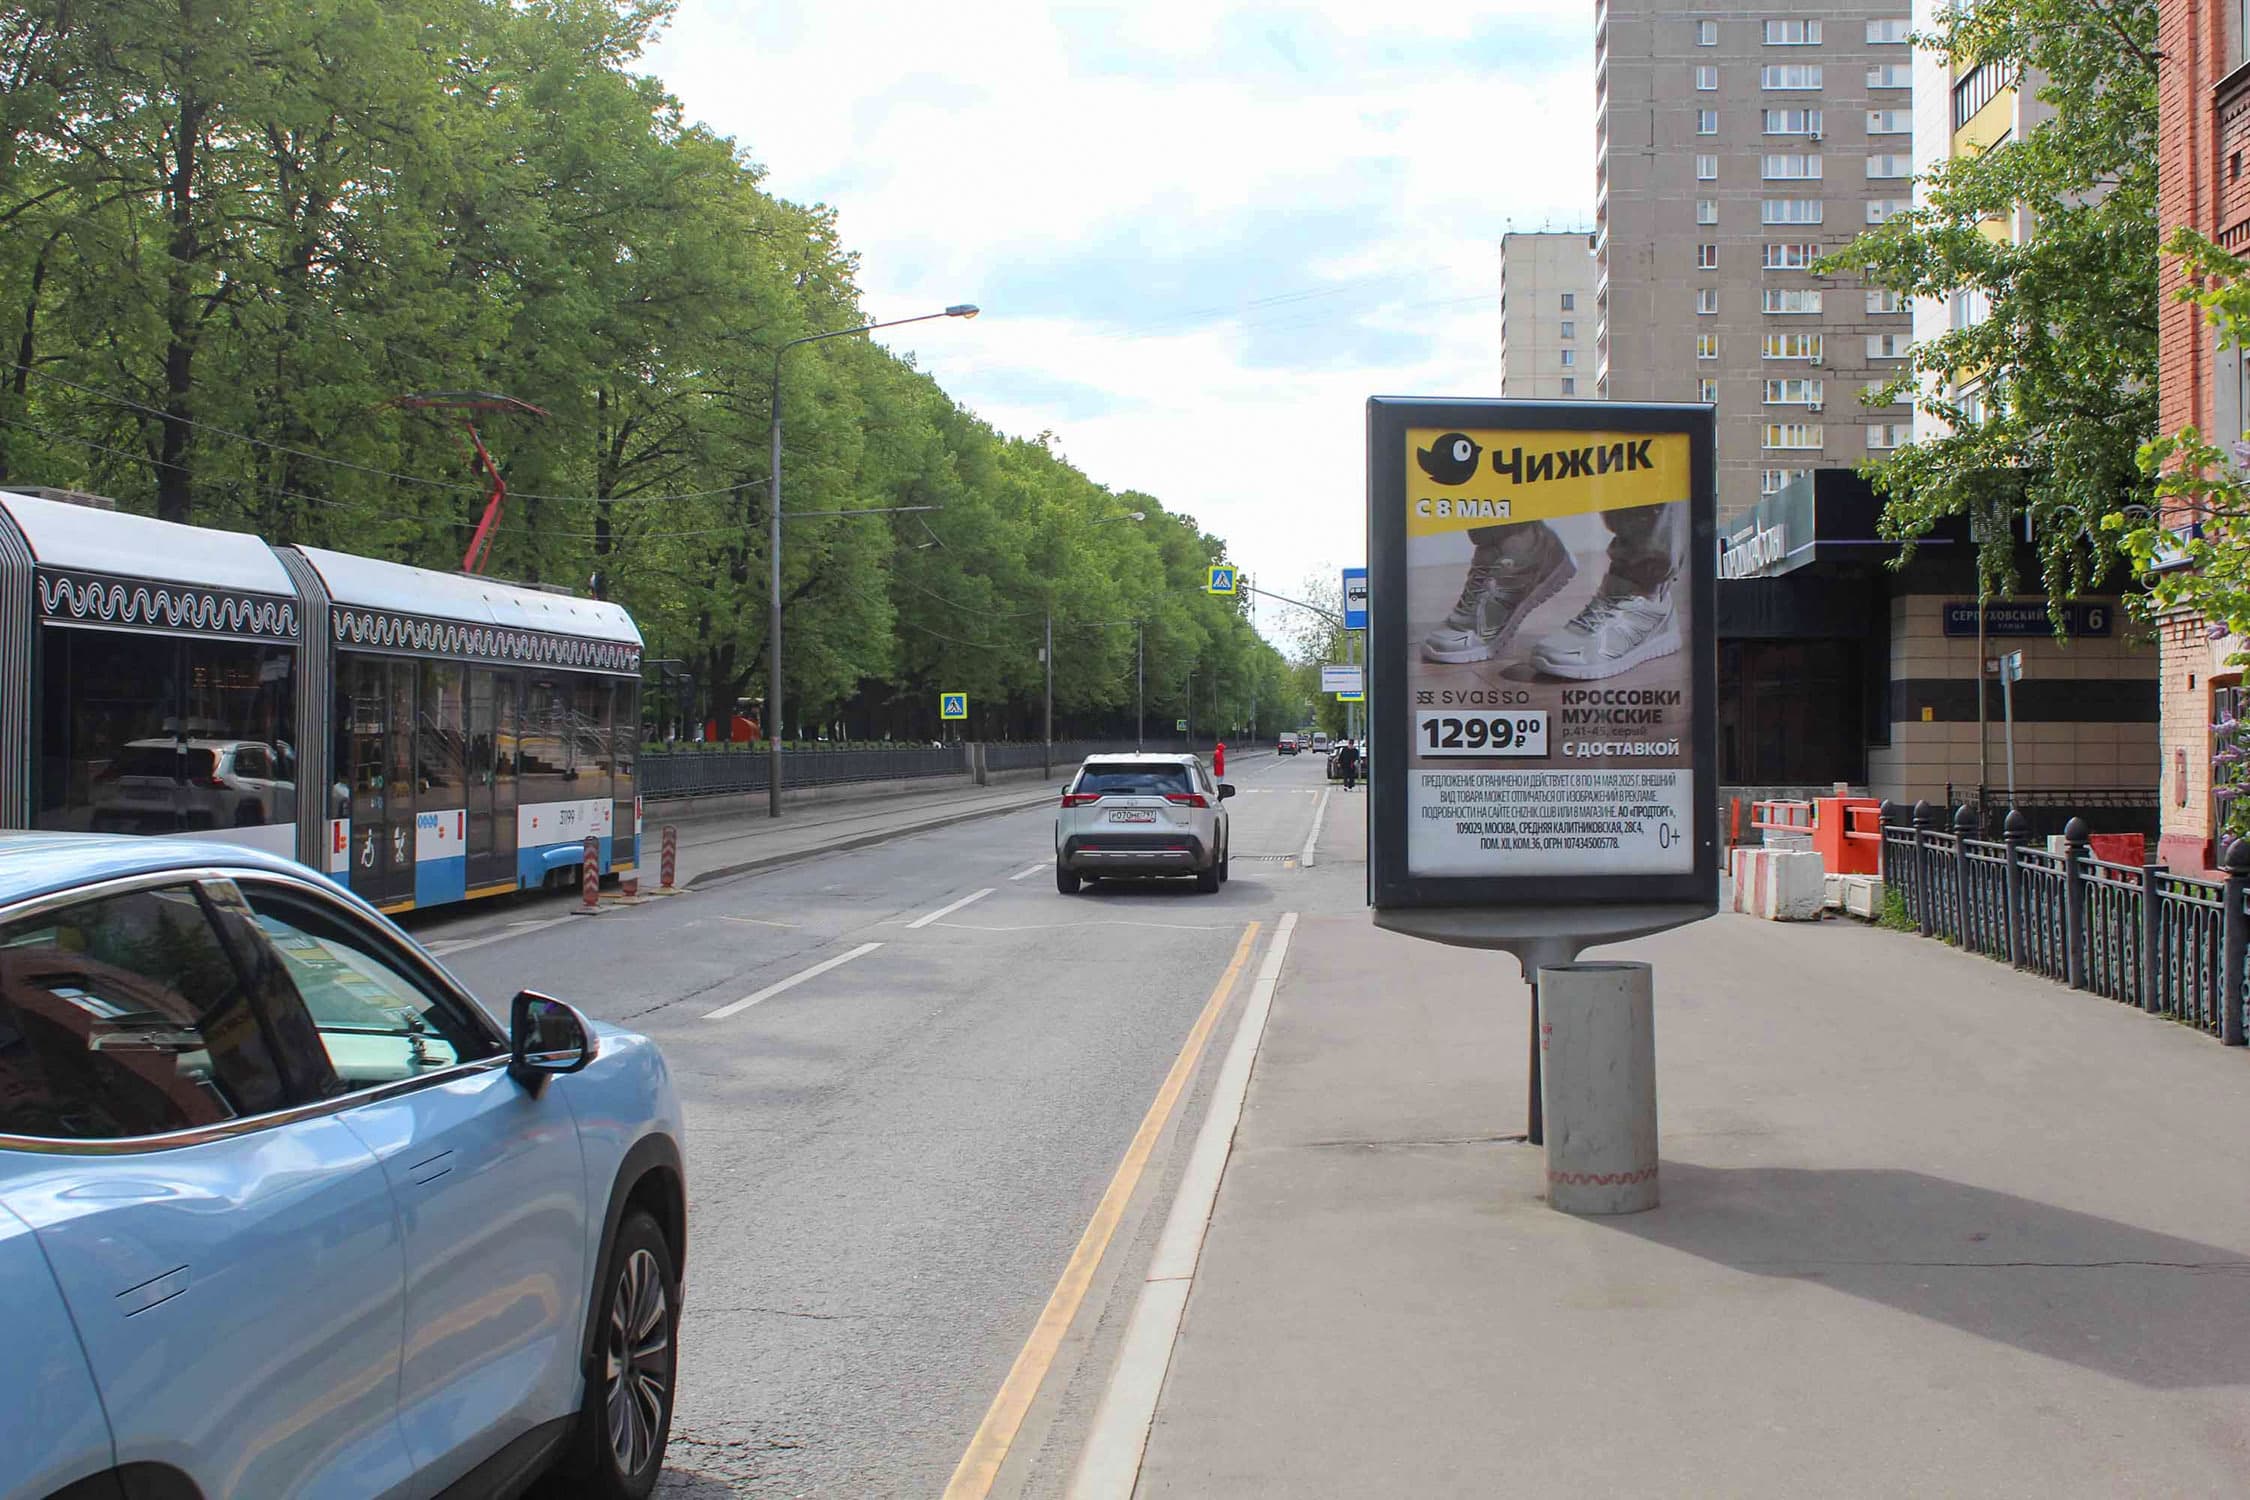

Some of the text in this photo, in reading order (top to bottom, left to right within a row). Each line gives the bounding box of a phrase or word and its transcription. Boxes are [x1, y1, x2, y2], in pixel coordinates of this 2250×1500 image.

[1415, 499, 1512, 518] С 8 МАЯ
[2088, 608, 2103, 629] 6
[1562, 690, 1681, 705] КРОССОВКИ
[1562, 708, 1664, 724] МУЖСКИЕ
[1421, 718, 1515, 749] 1299
[1562, 738, 1680, 758] С ДОСТАВКОЙ
[1422, 774, 1475, 789] ПРЕДЛОЖЕНИЕ
[1476, 774, 1523, 787] ОГРАНИЧЕНО
[1641, 771, 1677, 786] ВНЕШНИЙ
[1440, 790, 1456, 804] ВИД
[1457, 790, 1483, 802] ТОВАРА
[1484, 822, 1519, 835] МОСКВА,
[1519, 822, 1553, 835] СРЕДНЯЯ
[1659, 822, 1681, 849] 0+
